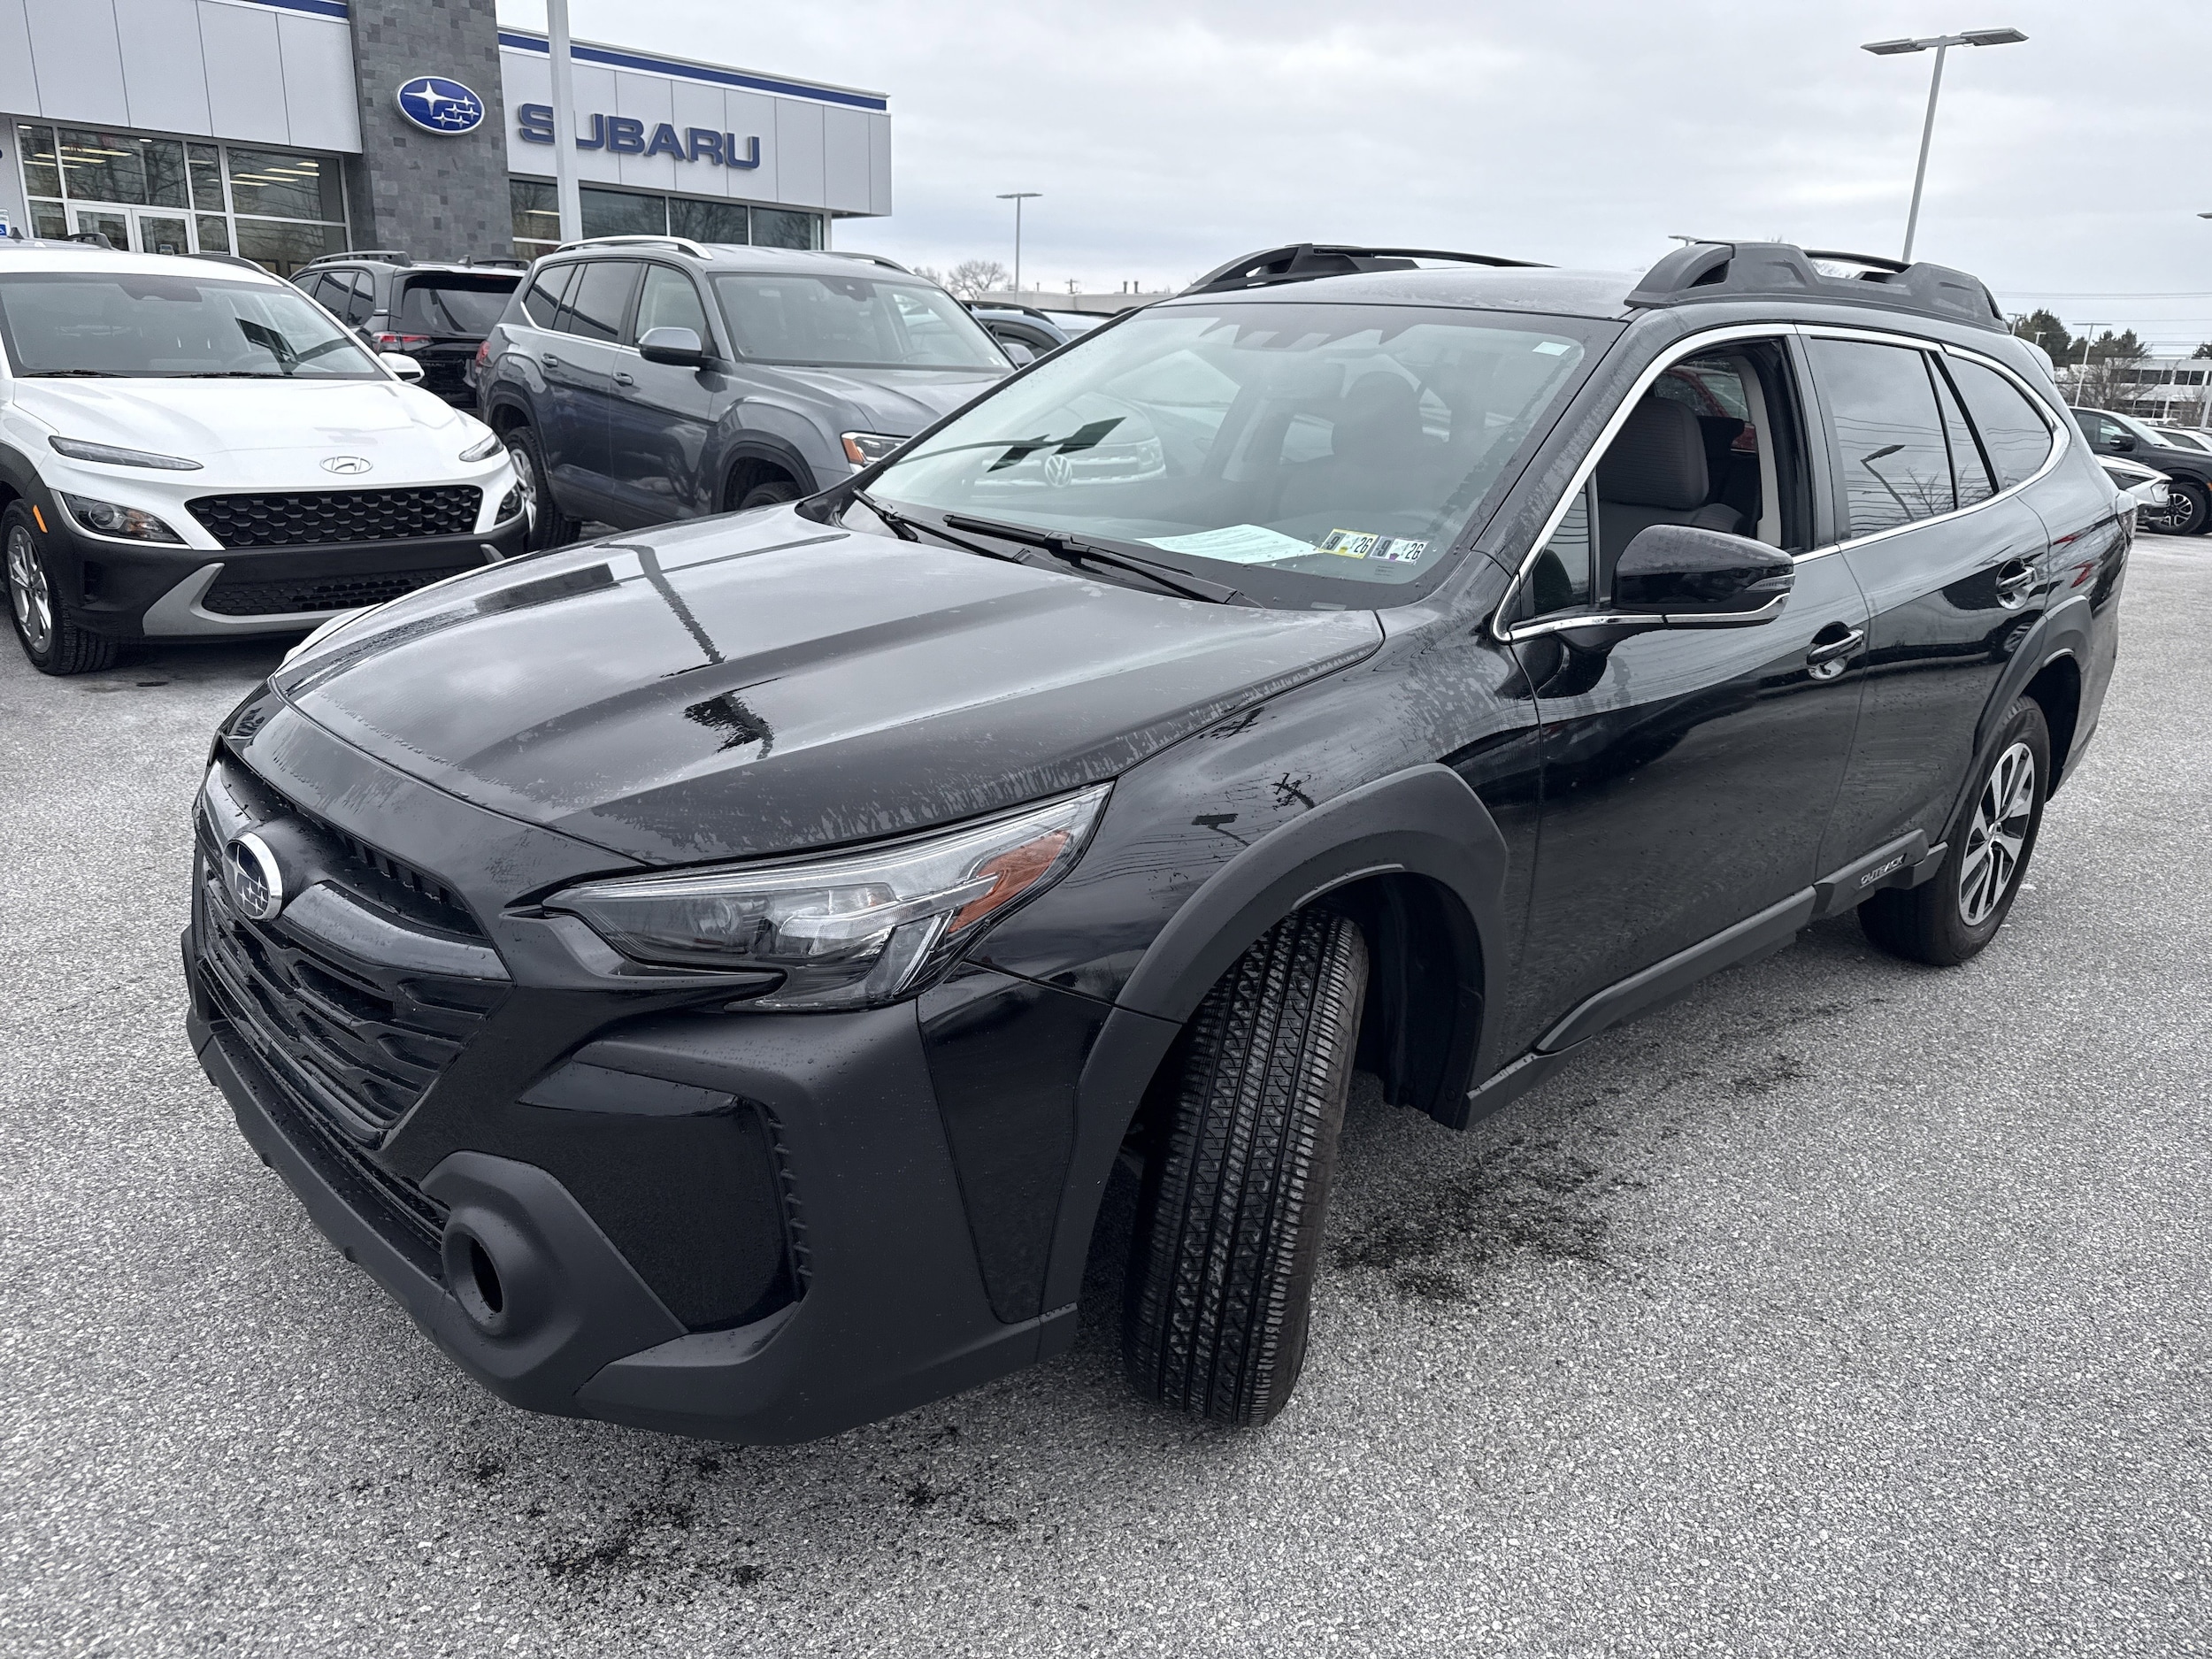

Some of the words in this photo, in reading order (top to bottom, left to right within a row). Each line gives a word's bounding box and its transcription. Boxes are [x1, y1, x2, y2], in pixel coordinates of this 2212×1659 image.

[518, 103, 760, 169] SUBARU
[1326, 535, 1340, 549] 9
[1354, 537, 1373, 553] 26
[1378, 540, 1392, 557] 9
[1405, 542, 1425, 559] 26
